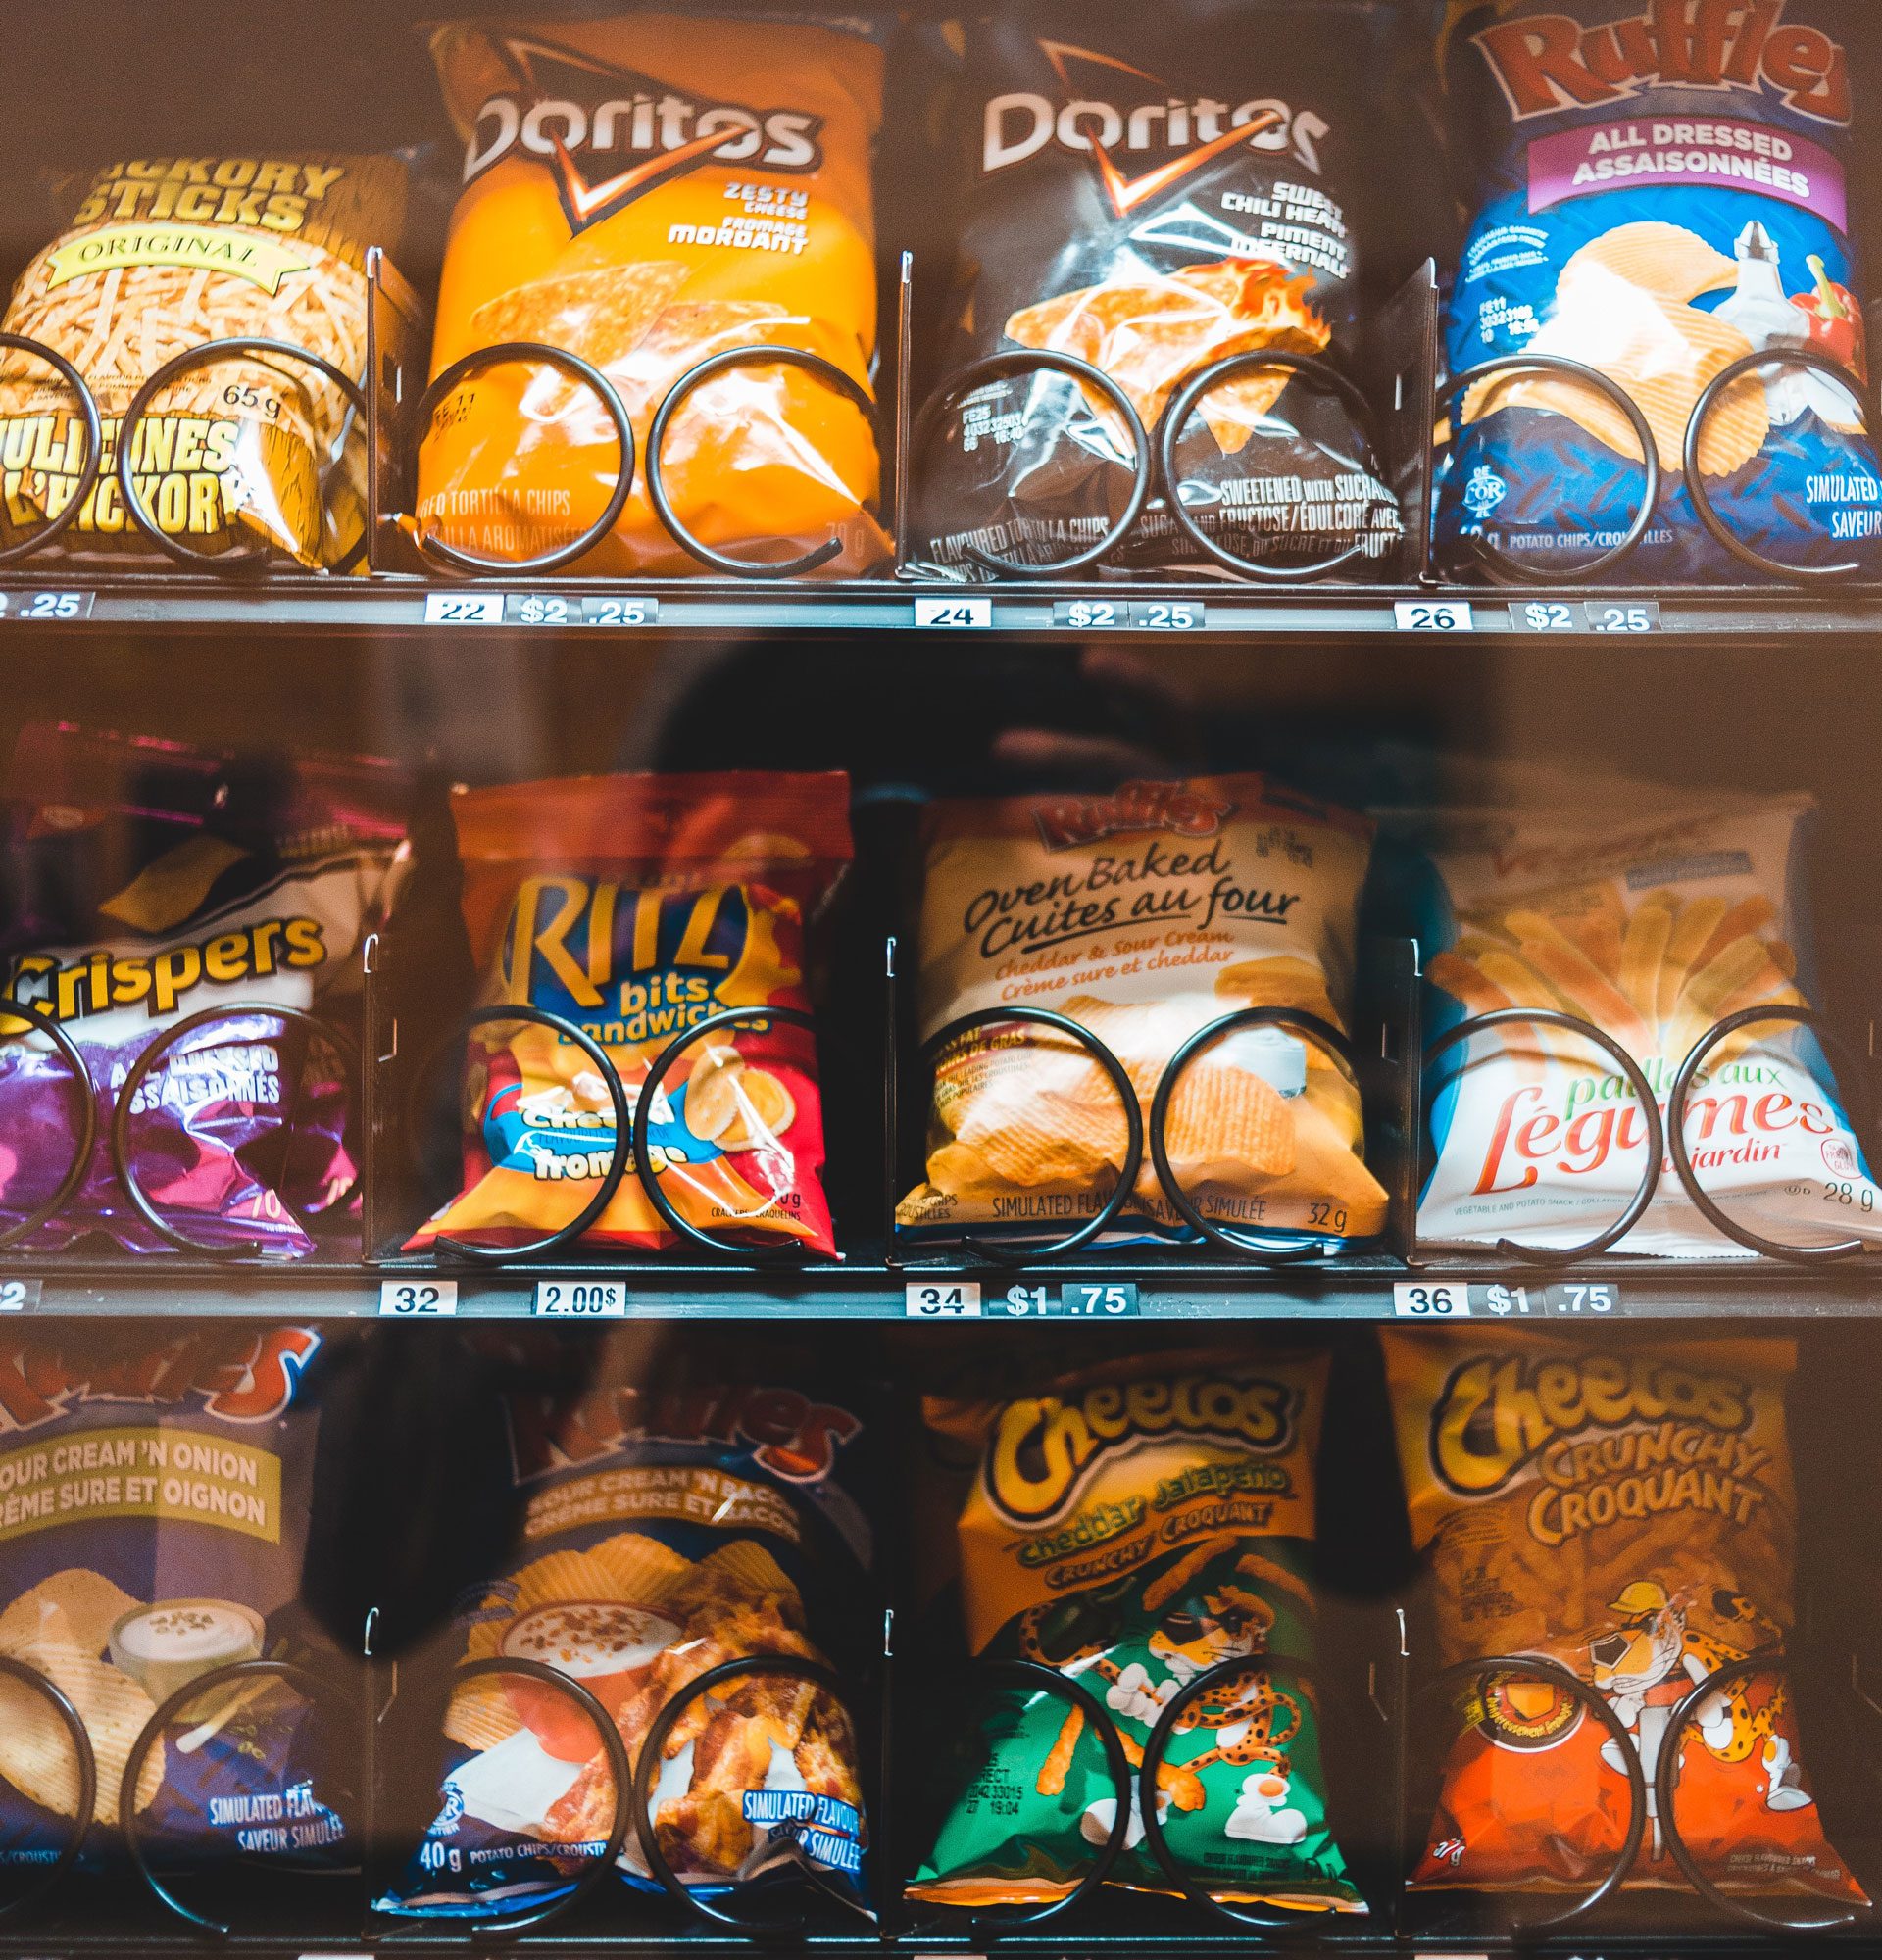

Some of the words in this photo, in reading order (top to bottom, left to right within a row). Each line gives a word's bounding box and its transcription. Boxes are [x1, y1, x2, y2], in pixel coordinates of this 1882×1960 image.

[464, 91, 816, 184] Doritos
[983, 92, 1330, 176] Doritos
[1588, 130, 1648, 156] ALL
[1653, 123, 1794, 162] DRESSED
[1571, 152, 1811, 198] ASSAISONNÉES
[73, 179, 310, 232] STICKS
[724, 182, 809, 208] ZESTY
[744, 200, 809, 220] CHEESE
[1221, 191, 1281, 218] CHILI
[668, 224, 810, 256] MORDANT
[722, 216, 809, 237] FROMAGE
[1261, 221, 1348, 260] PIMENT
[78, 233, 259, 268] ORIGINAL
[223, 385, 259, 406] 65
[265, 398, 281, 419] g
[526, 489, 571, 517] CHIPS
[1221, 475, 1302, 506] SWEETENED
[1303, 478, 1335, 503] WITH
[1806, 474, 1878, 504] SIMULATED
[1069, 516, 1111, 543] CHIPS
[1831, 510, 1882, 538] SAVEUR
[1510, 534, 1555, 549] POTATO
[19, 594, 81, 619] .25
[440, 599, 485, 621] 22
[520, 597, 569, 624] $2
[589, 600, 646, 625] .25
[929, 607, 974, 626] 24
[1068, 602, 1115, 628] $2
[1139, 604, 1193, 629] .25
[1411, 608, 1455, 630] 26
[1525, 603, 1572, 630] $2
[1596, 607, 1651, 632] .25
[963, 870, 1085, 935] Oven
[1081, 838, 1232, 893] Baked
[980, 896, 1117, 958] Cuites
[1130, 885, 1204, 918] au
[1197, 876, 1302, 931] four
[509, 874, 731, 1007] RITZ
[1087, 944, 1108, 962] &
[1114, 934, 1162, 956] Sour
[1164, 930, 1235, 948] Cream
[10, 916, 326, 1021] Crispers
[1001, 978, 1069, 1001] Crème
[1071, 964, 1118, 986] sure
[1120, 957, 1143, 976] et
[1146, 945, 1235, 971] cheddar
[620, 972, 710, 1017] bits
[1717, 1061, 1787, 1089] aux
[1469, 1085, 1835, 1197] Légumes
[1691, 1137, 1780, 1172] jardin
[792, 1192, 801, 1208] g
[992, 1194, 1073, 1218] SIMULATED
[1205, 1192, 1267, 1221] SIMULÉE
[1454, 1204, 1498, 1216] VEGETABLE
[1499, 1202, 1514, 1212] AND
[1515, 1198, 1547, 1210] POTATO
[1823, 1182, 1853, 1205] 28
[1860, 1189, 1874, 1213] g
[1307, 1202, 1331, 1226] 32
[1334, 1209, 1347, 1233] g
[394, 1286, 440, 1313] 32
[545, 1286, 618, 1314] 2.00$
[919, 1288, 965, 1315] 34
[1006, 1283, 1048, 1316] $1
[1070, 1287, 1127, 1315] .75
[1408, 1287, 1453, 1314] 36
[1487, 1285, 1530, 1315] $1
[1558, 1286, 1612, 1312] .75
[1435, 1353, 1753, 1491] Cheetos
[992, 1376, 1287, 1515] Cheetos
[1539, 1420, 1771, 1488] CRUNCHY
[0, 1453, 48, 1492] OUR
[52, 1441, 136, 1475] CREAM
[140, 1440, 168, 1469] 'N
[173, 1442, 258, 1487] ONION
[599, 1471, 689, 1492] CREAM
[0, 1487, 55, 1528] ÈME
[60, 1476, 122, 1510] SURE
[125, 1476, 158, 1504] ET
[163, 1479, 266, 1526] OIGNON
[613, 1492, 681, 1511] SURE
[685, 1494, 716, 1517] ET
[1528, 1468, 1764, 1548] CROQUANT
[1047, 1534, 1156, 1588] CRUNCHY
[1161, 1502, 1274, 1545] CROQUANT
[210, 1795, 282, 1825] SIMULATED
[744, 1791, 816, 1821] SIMULATED
[237, 1827, 288, 1853] SAVEUR
[420, 1841, 444, 1870] 40
[449, 1847, 462, 1873] g
[470, 1846, 515, 1864] POTATO
